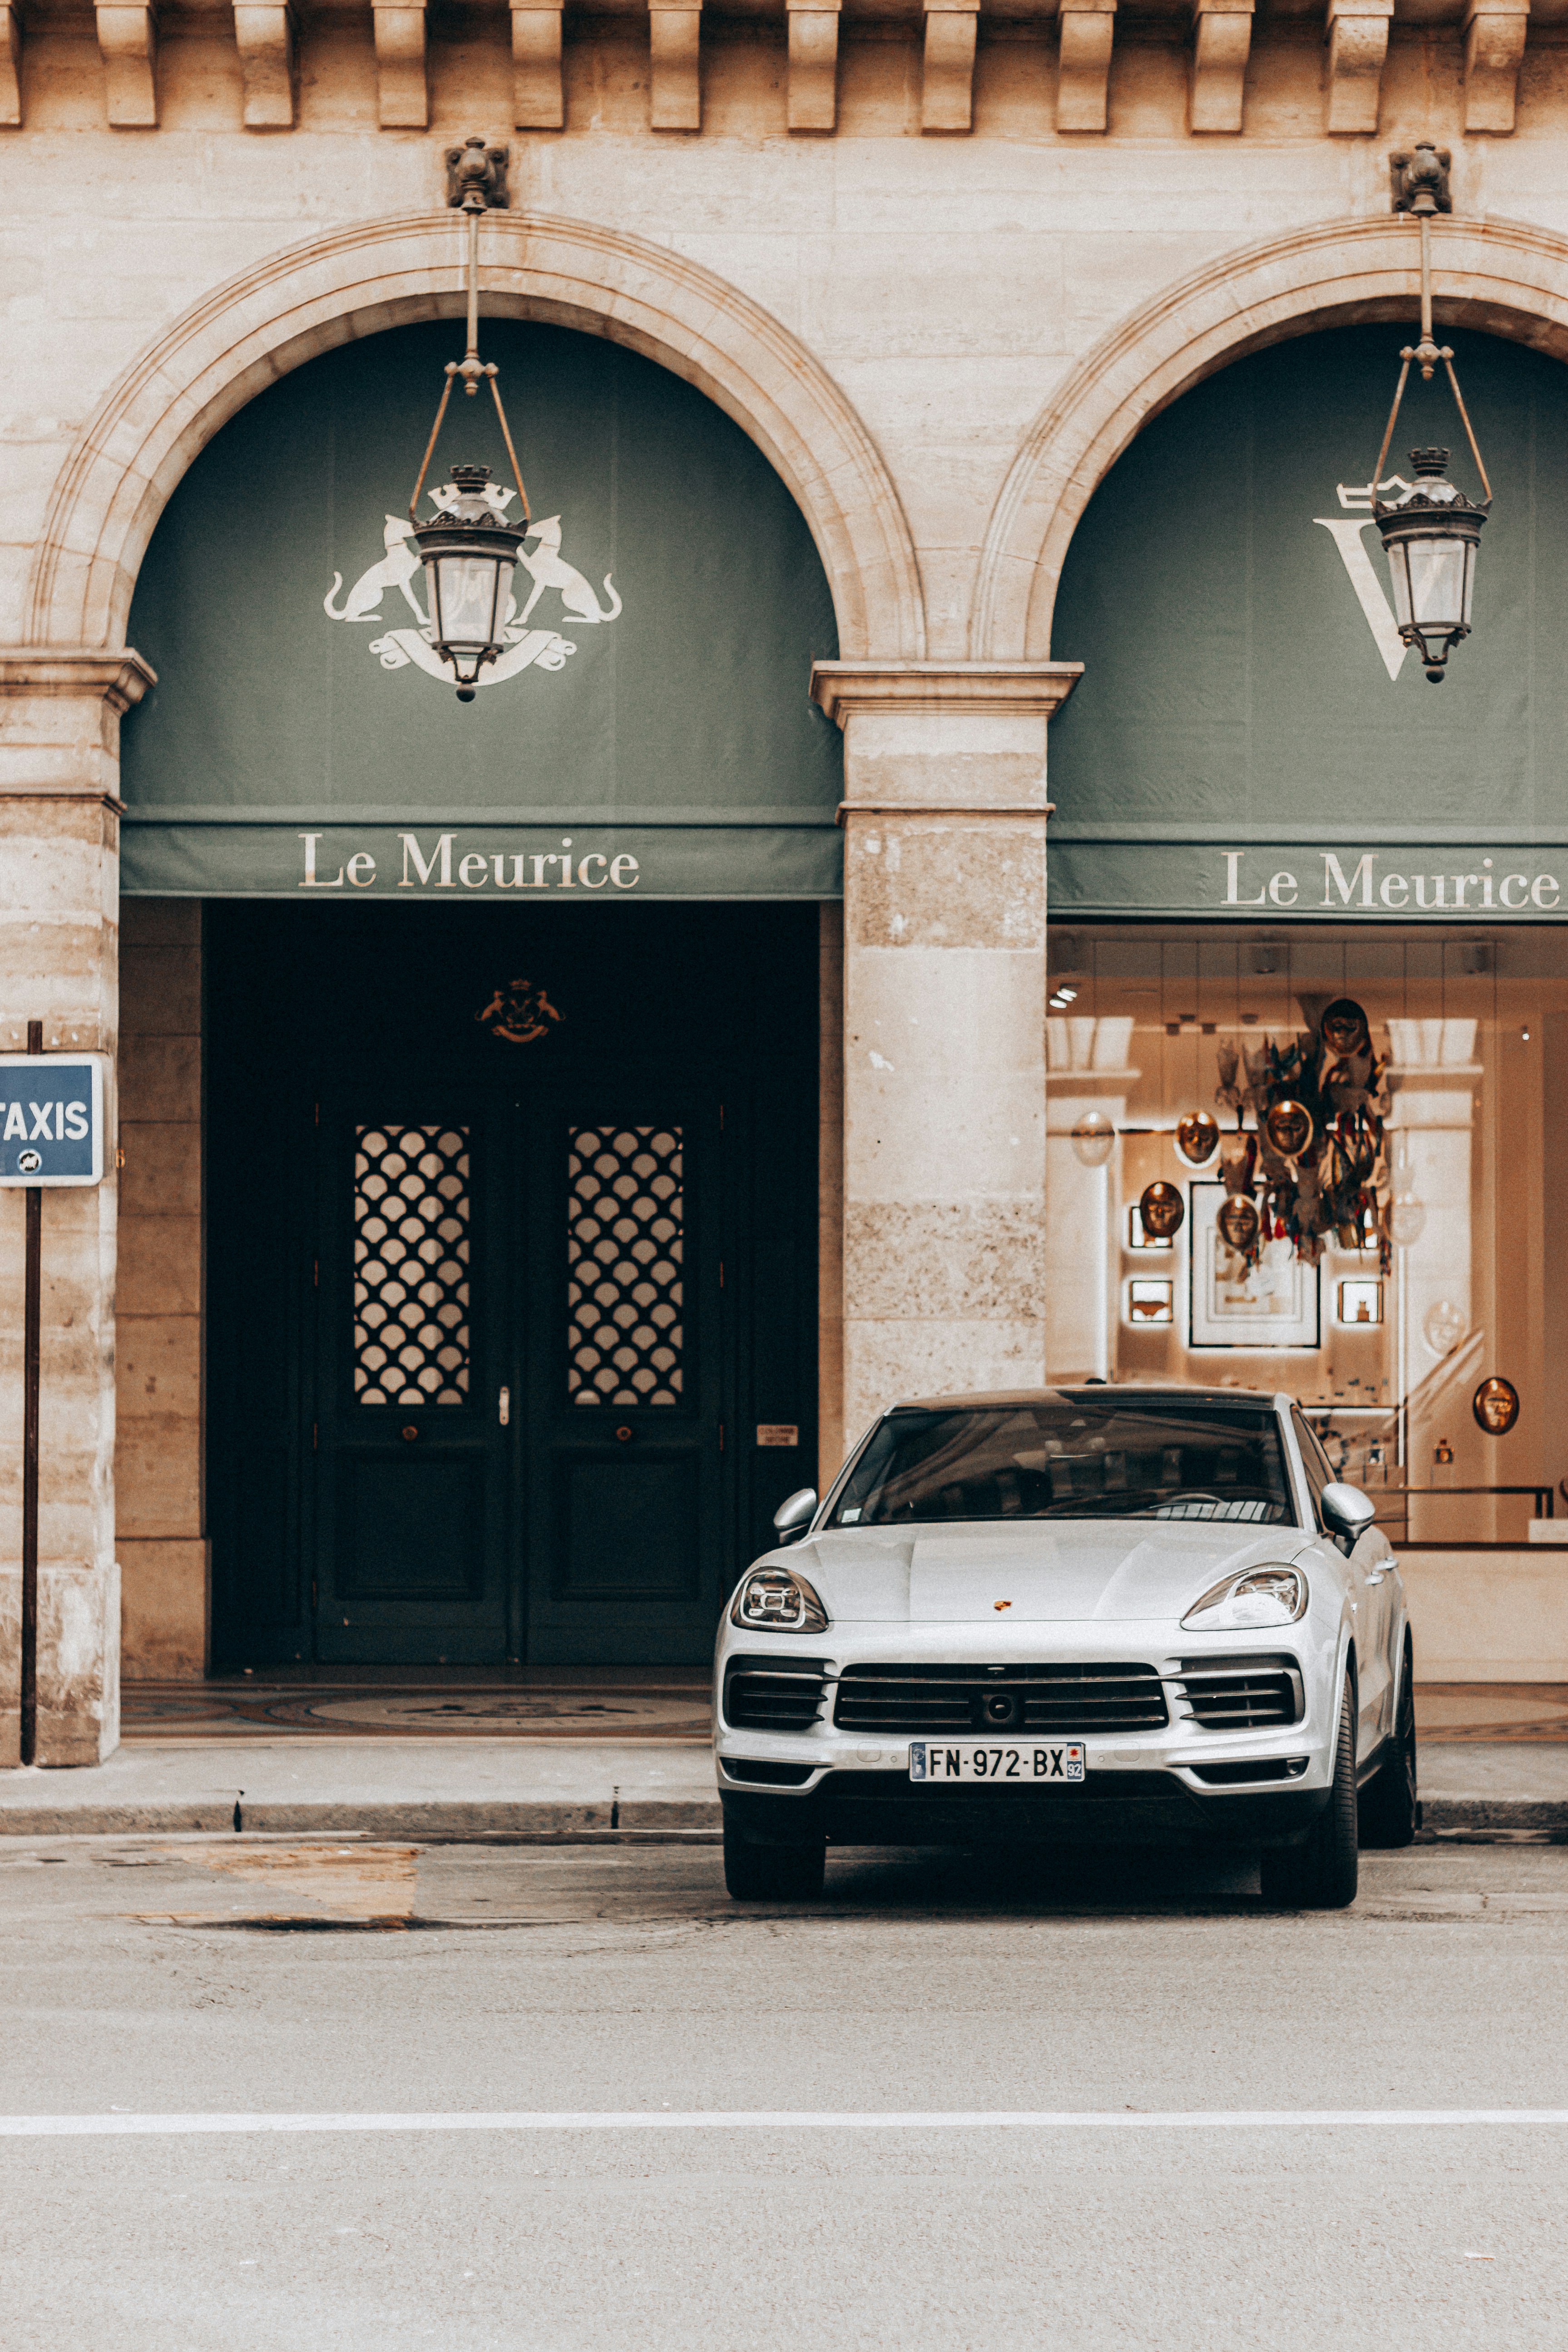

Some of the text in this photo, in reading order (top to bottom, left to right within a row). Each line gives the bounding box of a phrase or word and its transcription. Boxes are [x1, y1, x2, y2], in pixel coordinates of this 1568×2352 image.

[297, 832, 640, 888] Le Meurice
[1220, 851, 1561, 909] Le Meurice
[0, 1101, 89, 1141] AXIS
[929, 1749, 1082, 1777] FN-972-BX 92
